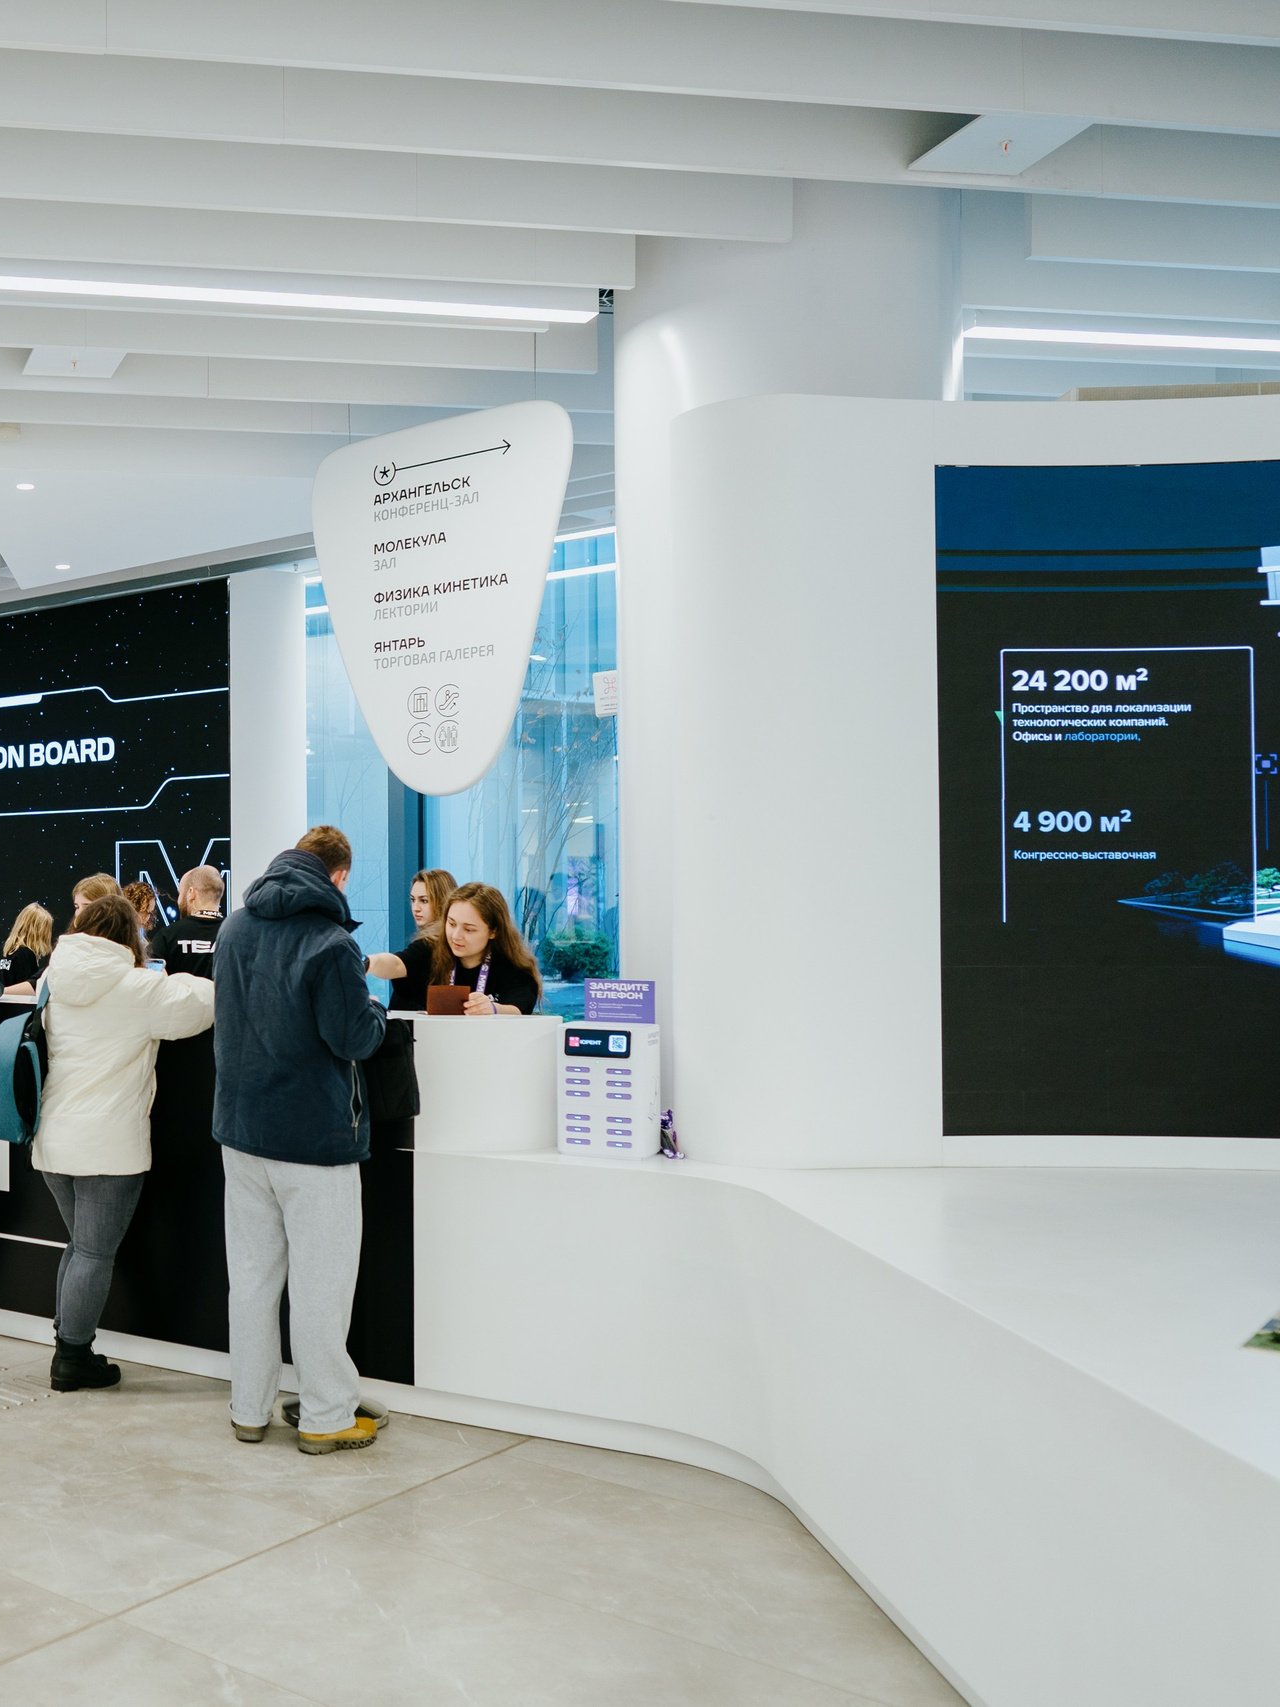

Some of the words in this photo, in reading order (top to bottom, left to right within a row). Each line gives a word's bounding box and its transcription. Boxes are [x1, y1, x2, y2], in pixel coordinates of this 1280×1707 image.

[373, 475, 471, 506] АРХАНГЕЛЬСК
[373, 491, 479, 522] КОНФЕРЕНЦ-ЗАЛ
[373, 532, 447, 555] МОЛЕКУЛА
[373, 557, 397, 571] ЗАЛ
[373, 585, 430, 604] ФИЗИКА
[433, 573, 509, 595] КИНЕТИКА
[373, 601, 438, 621] ЛЕКТОРИИ
[373, 637, 426, 653] ЯНТАРЬ
[373, 651, 436, 670] ТОРГОВАЯ
[439, 644, 495, 663] ГАЛЕРЕЯ
[1011, 669, 1048, 691] 24
[1053, 669, 1109, 691] 200
[1012, 703, 1090, 715] Пространство
[1091, 704, 1113, 715] для
[1115, 704, 1192, 714] локализации
[1012, 718, 1107, 729] технологических
[1108, 716, 1169, 728] компаний.
[1012, 730, 1053, 743] Офисы
[1054, 733, 1063, 741] и
[1064, 731, 1141, 742] лаборатории,
[29, 737, 116, 767] BOARD
[1013, 811, 1031, 832] 4
[1037, 810, 1093, 832] 900
[1013, 850, 1157, 862] Конгрессно-выставочная
[589, 982, 650, 992] ЗАРЯДИТЕ
[589, 991, 644, 1000] ТЕЛЕФОН
